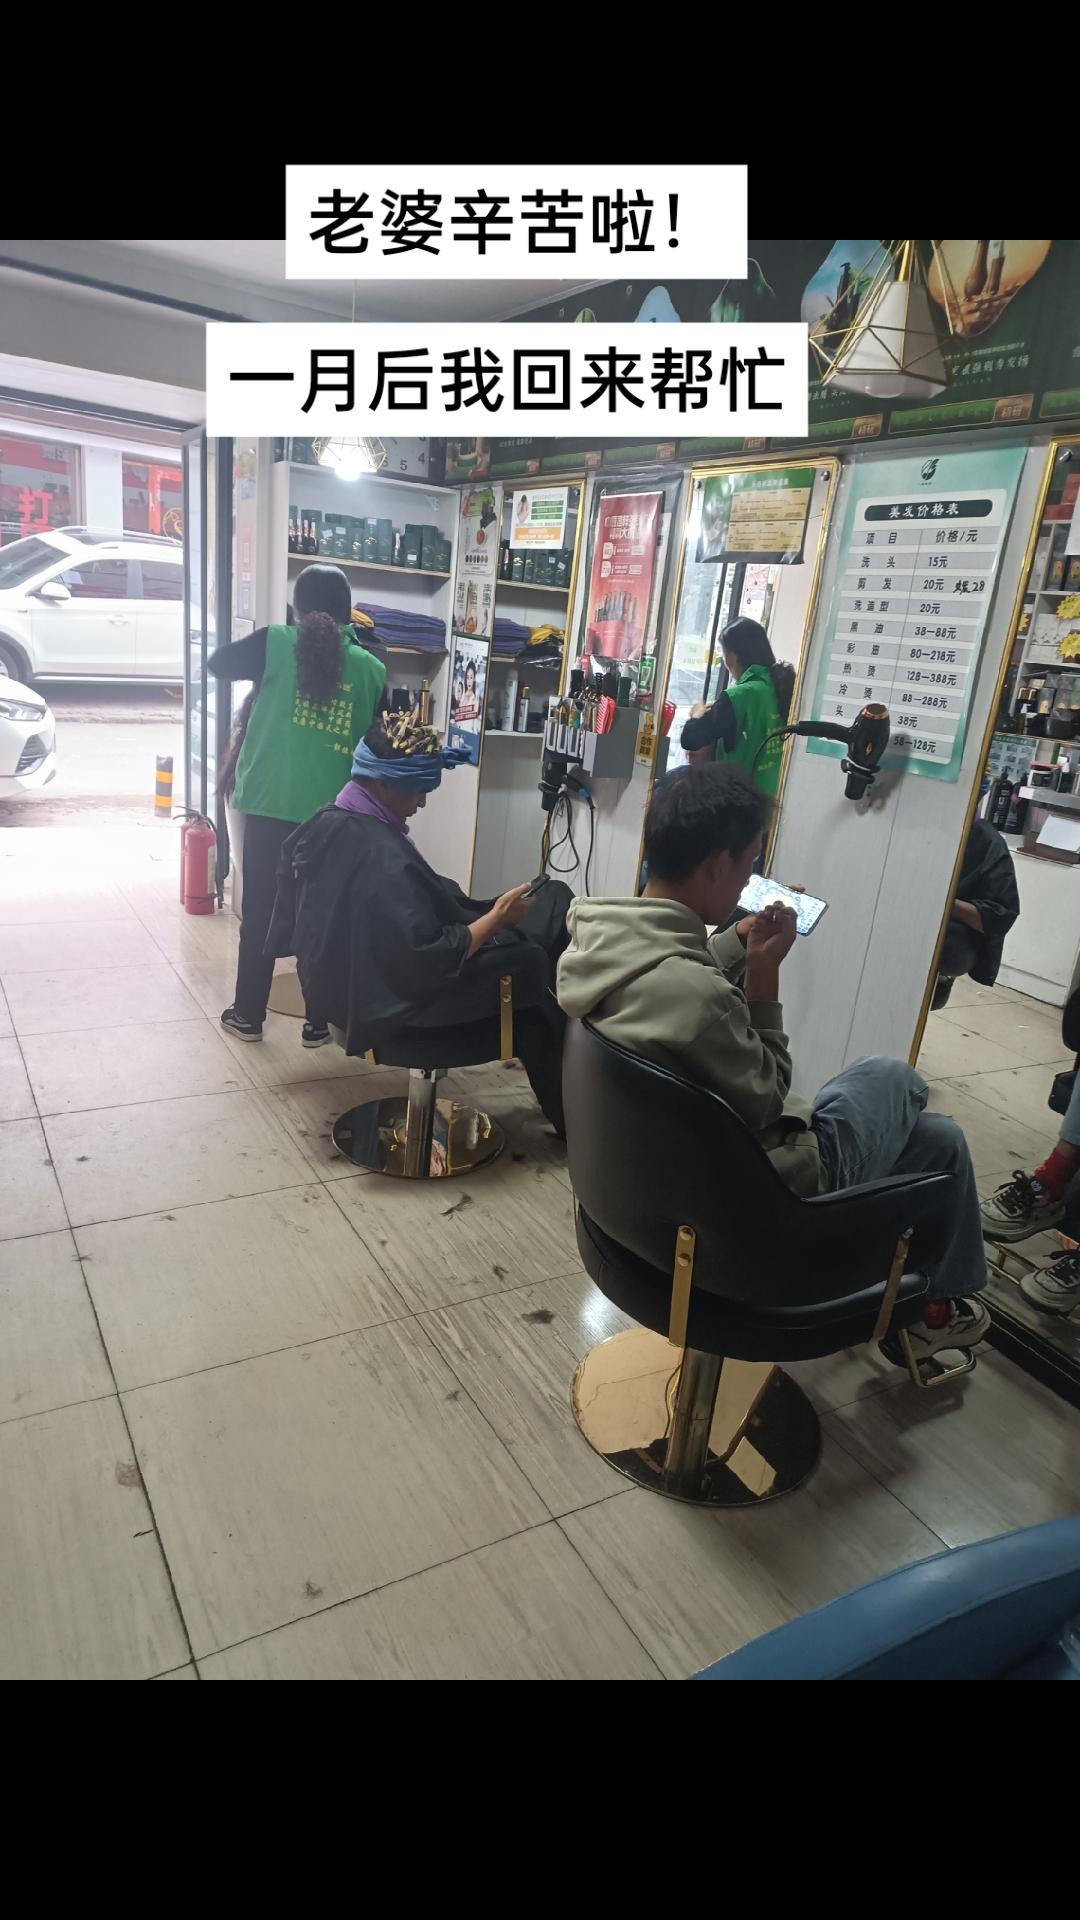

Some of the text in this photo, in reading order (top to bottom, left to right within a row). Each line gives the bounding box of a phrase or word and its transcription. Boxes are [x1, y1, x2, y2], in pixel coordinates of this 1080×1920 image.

[399, 459, 408, 471] 5
[889, 502, 959, 519] 美发价格表
[935, 529, 978, 543] 价格/元
[928, 555, 948, 568] 15元
[923, 578, 944, 591] 20元
[920, 603, 941, 615] 20元
[897, 715, 918, 728] 38元
